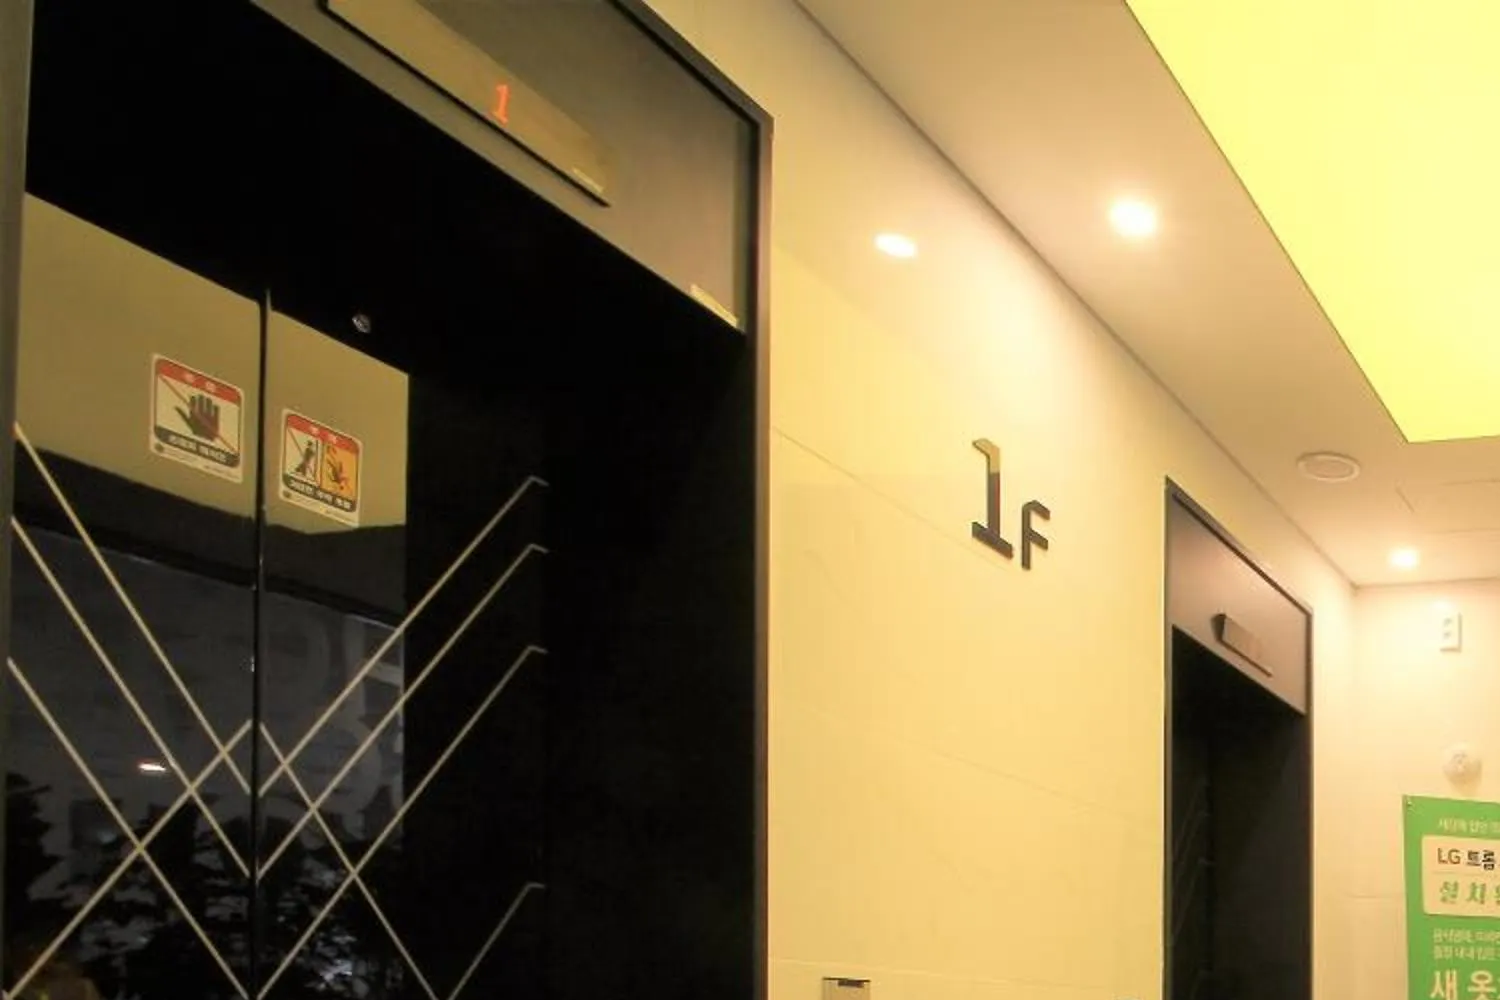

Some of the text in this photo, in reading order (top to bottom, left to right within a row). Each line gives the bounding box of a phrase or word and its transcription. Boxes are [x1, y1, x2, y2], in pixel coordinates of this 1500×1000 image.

[496, 84, 509, 127] 1
[1437, 848, 1461, 865] LG
[1466, 850, 1496, 871] 트롬
